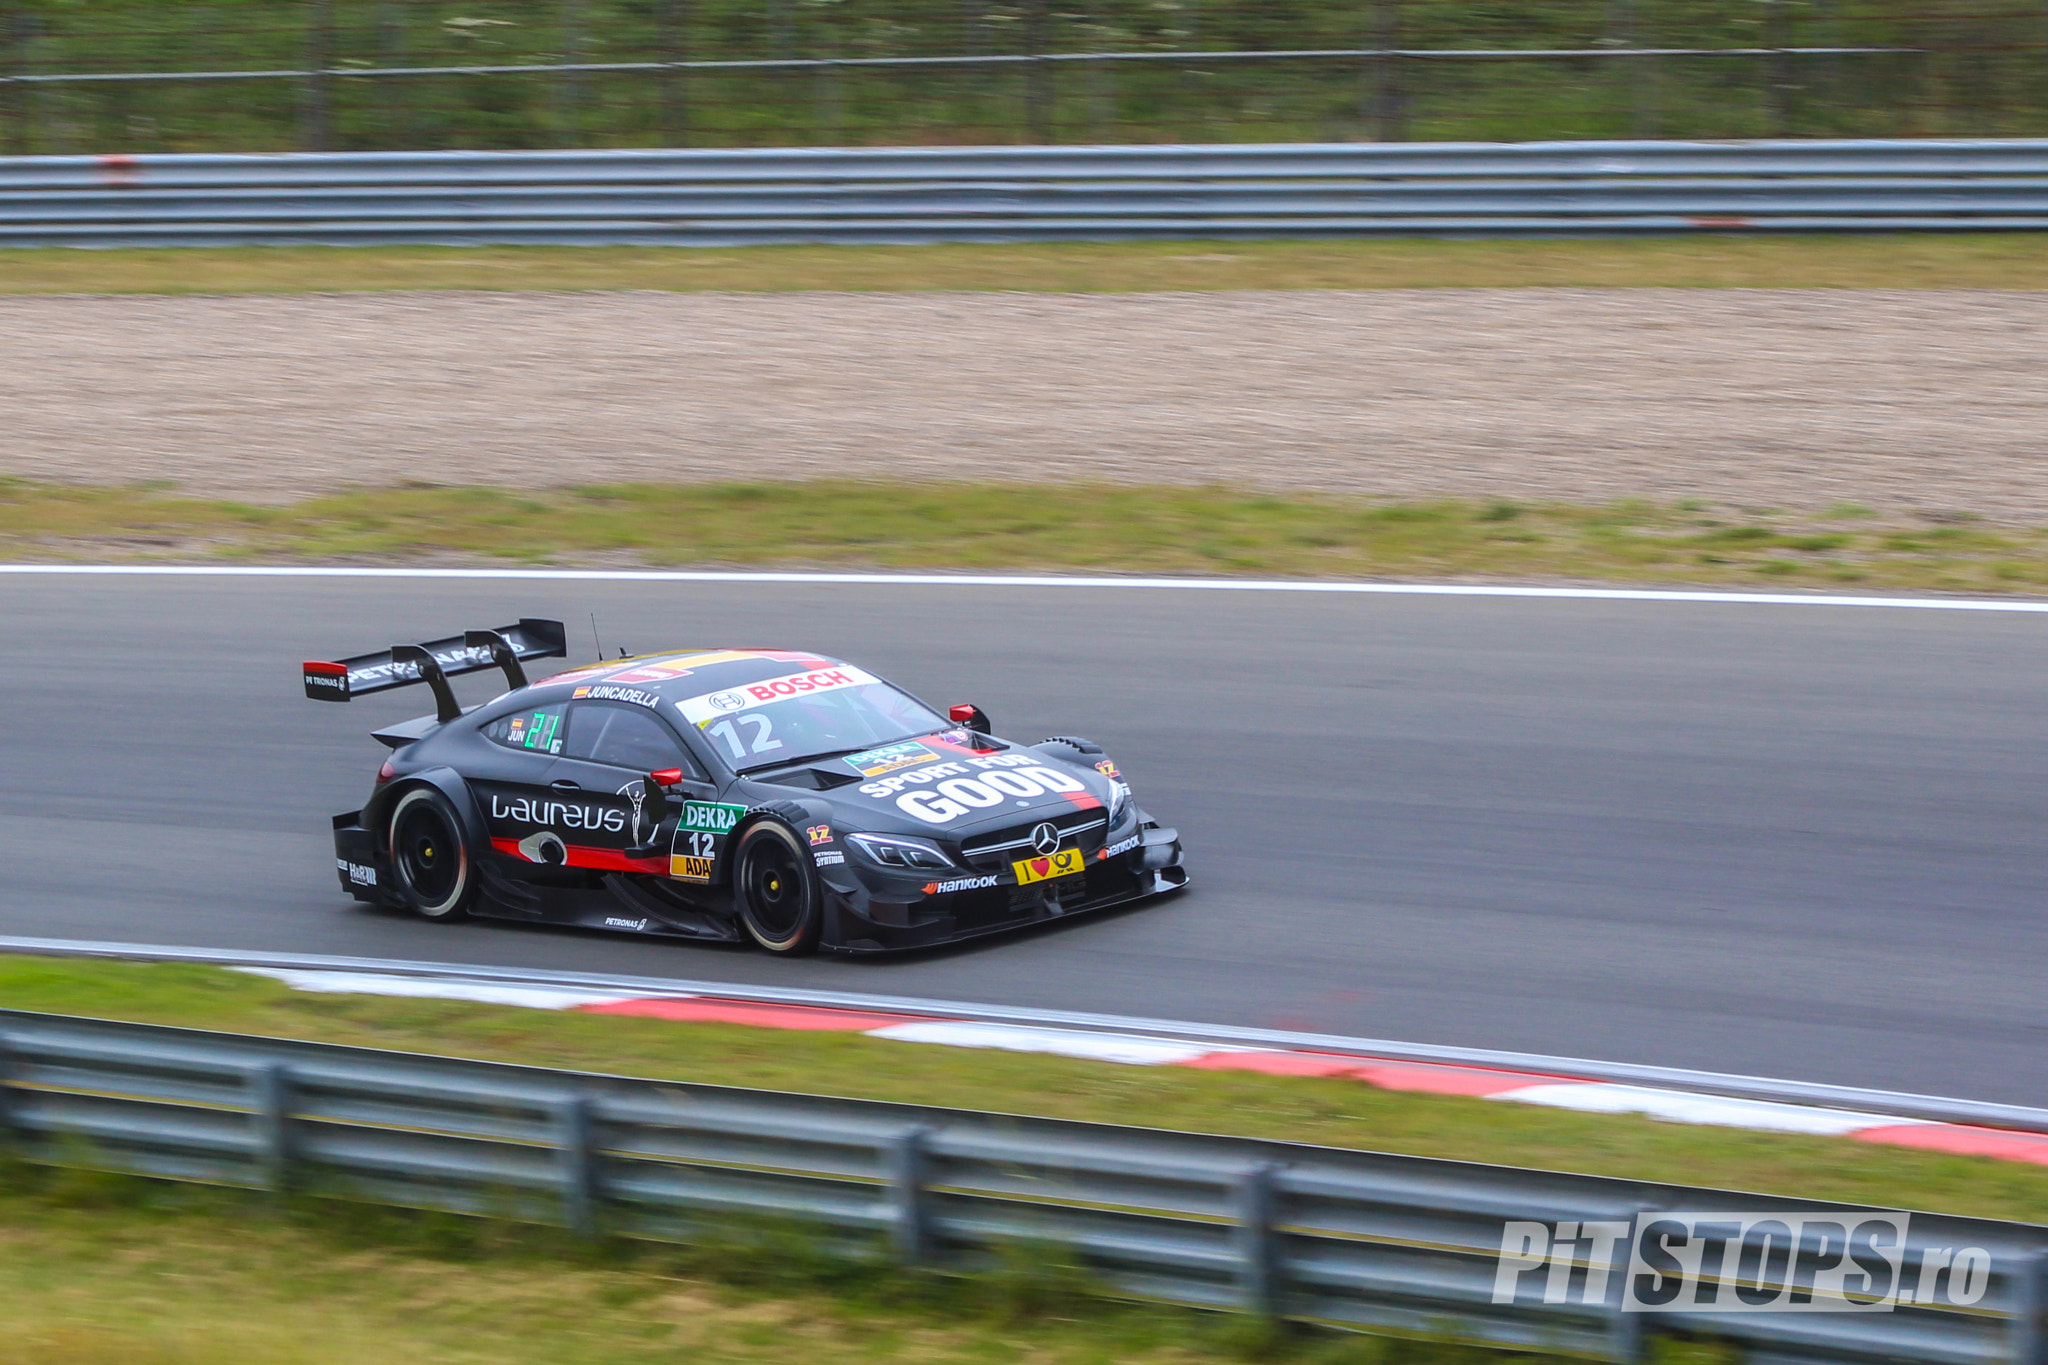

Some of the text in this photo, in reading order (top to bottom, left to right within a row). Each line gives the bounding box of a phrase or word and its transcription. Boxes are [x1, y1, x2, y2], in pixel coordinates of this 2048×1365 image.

[587, 686, 660, 708] JUNCADELLA
[747, 670, 854, 700] BOSCH
[508, 730, 525, 742] JUN
[524, 712, 560, 749] 21
[709, 713, 783, 758] 12
[859, 762, 970, 798] SPORT
[964, 754, 1042, 769] FOR
[896, 766, 1085, 823] GOOD
[686, 805, 737, 829] DEKRA
[689, 832, 716, 858] 12
[806, 824, 834, 846] 12
[685, 858, 712, 876] ADA
[1022, 862, 1031, 881] I
[605, 917, 639, 928] PETRONAS
